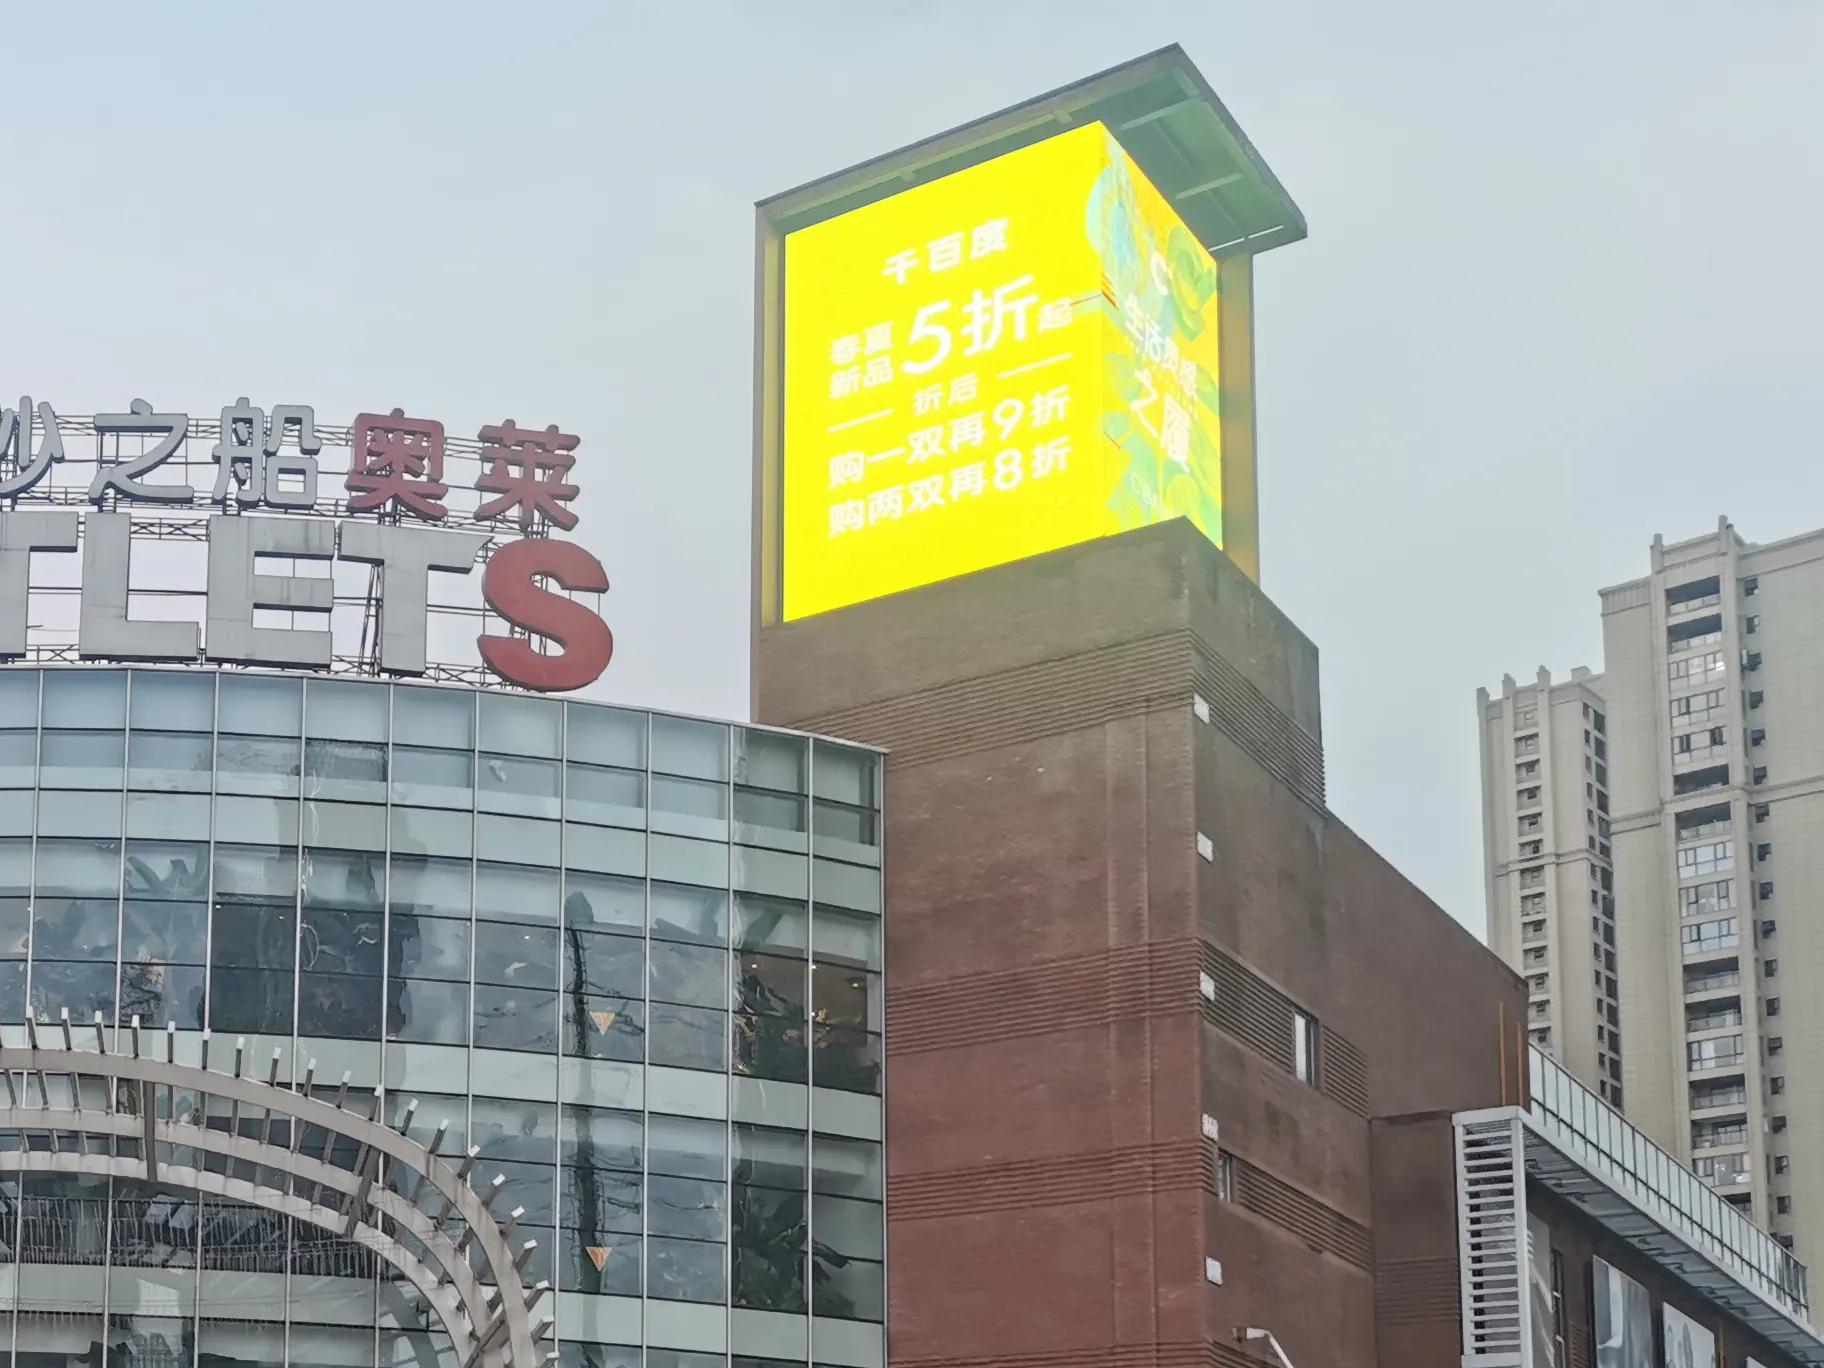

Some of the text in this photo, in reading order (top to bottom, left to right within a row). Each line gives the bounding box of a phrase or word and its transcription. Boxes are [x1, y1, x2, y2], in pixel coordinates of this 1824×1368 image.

[882, 217, 1009, 285] 千百度
[828, 384, 1072, 491] 购一双再9折
[828, 436, 1072, 539] 购两双再8折
